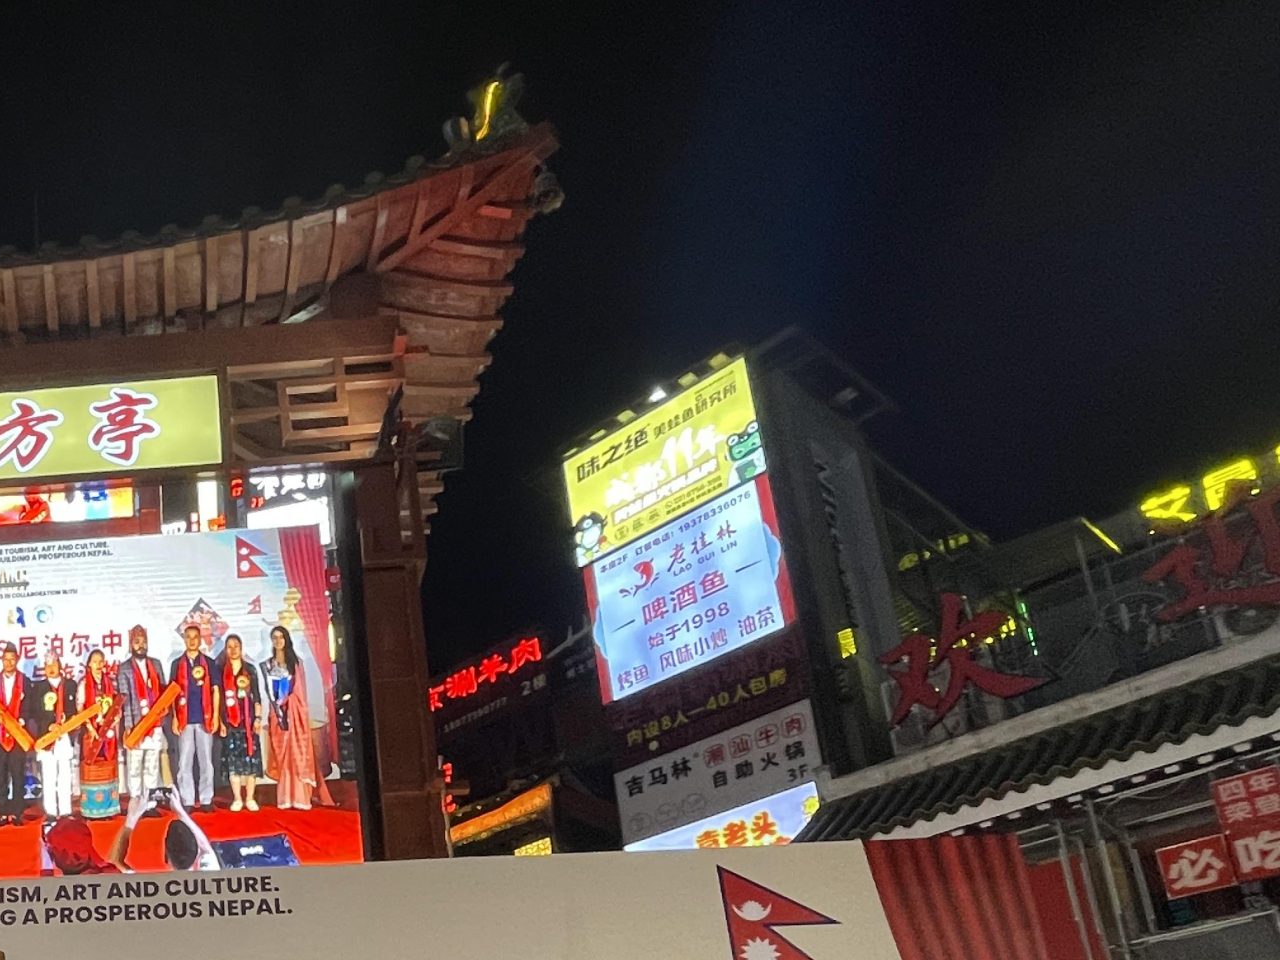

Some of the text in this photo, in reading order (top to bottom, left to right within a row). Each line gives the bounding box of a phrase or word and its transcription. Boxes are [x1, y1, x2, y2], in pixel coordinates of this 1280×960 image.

[577, 427, 649, 484] 味之绝
[667, 520, 738, 573] 老桂林
[673, 540, 738, 577] LAO GUI LIN
[642, 570, 729, 625] 啤酒鱼
[648, 602, 730, 649] 始于1998
[660, 628, 728, 671] 风味小炒
[739, 606, 776, 637] 油茶
[625, 757, 693, 797] 吉马林
[712, 741, 806, 788] 自助火锅
[787, 764, 809, 782] 3F
[22, 908, 39, 925] A
[44, 902, 203, 924] PROSPEROUS
[209, 898, 294, 918] NEPAL.
[55, 883, 101, 902] ART
[107, 880, 159, 899] AND
[165, 876, 280, 897] CULTURE.
